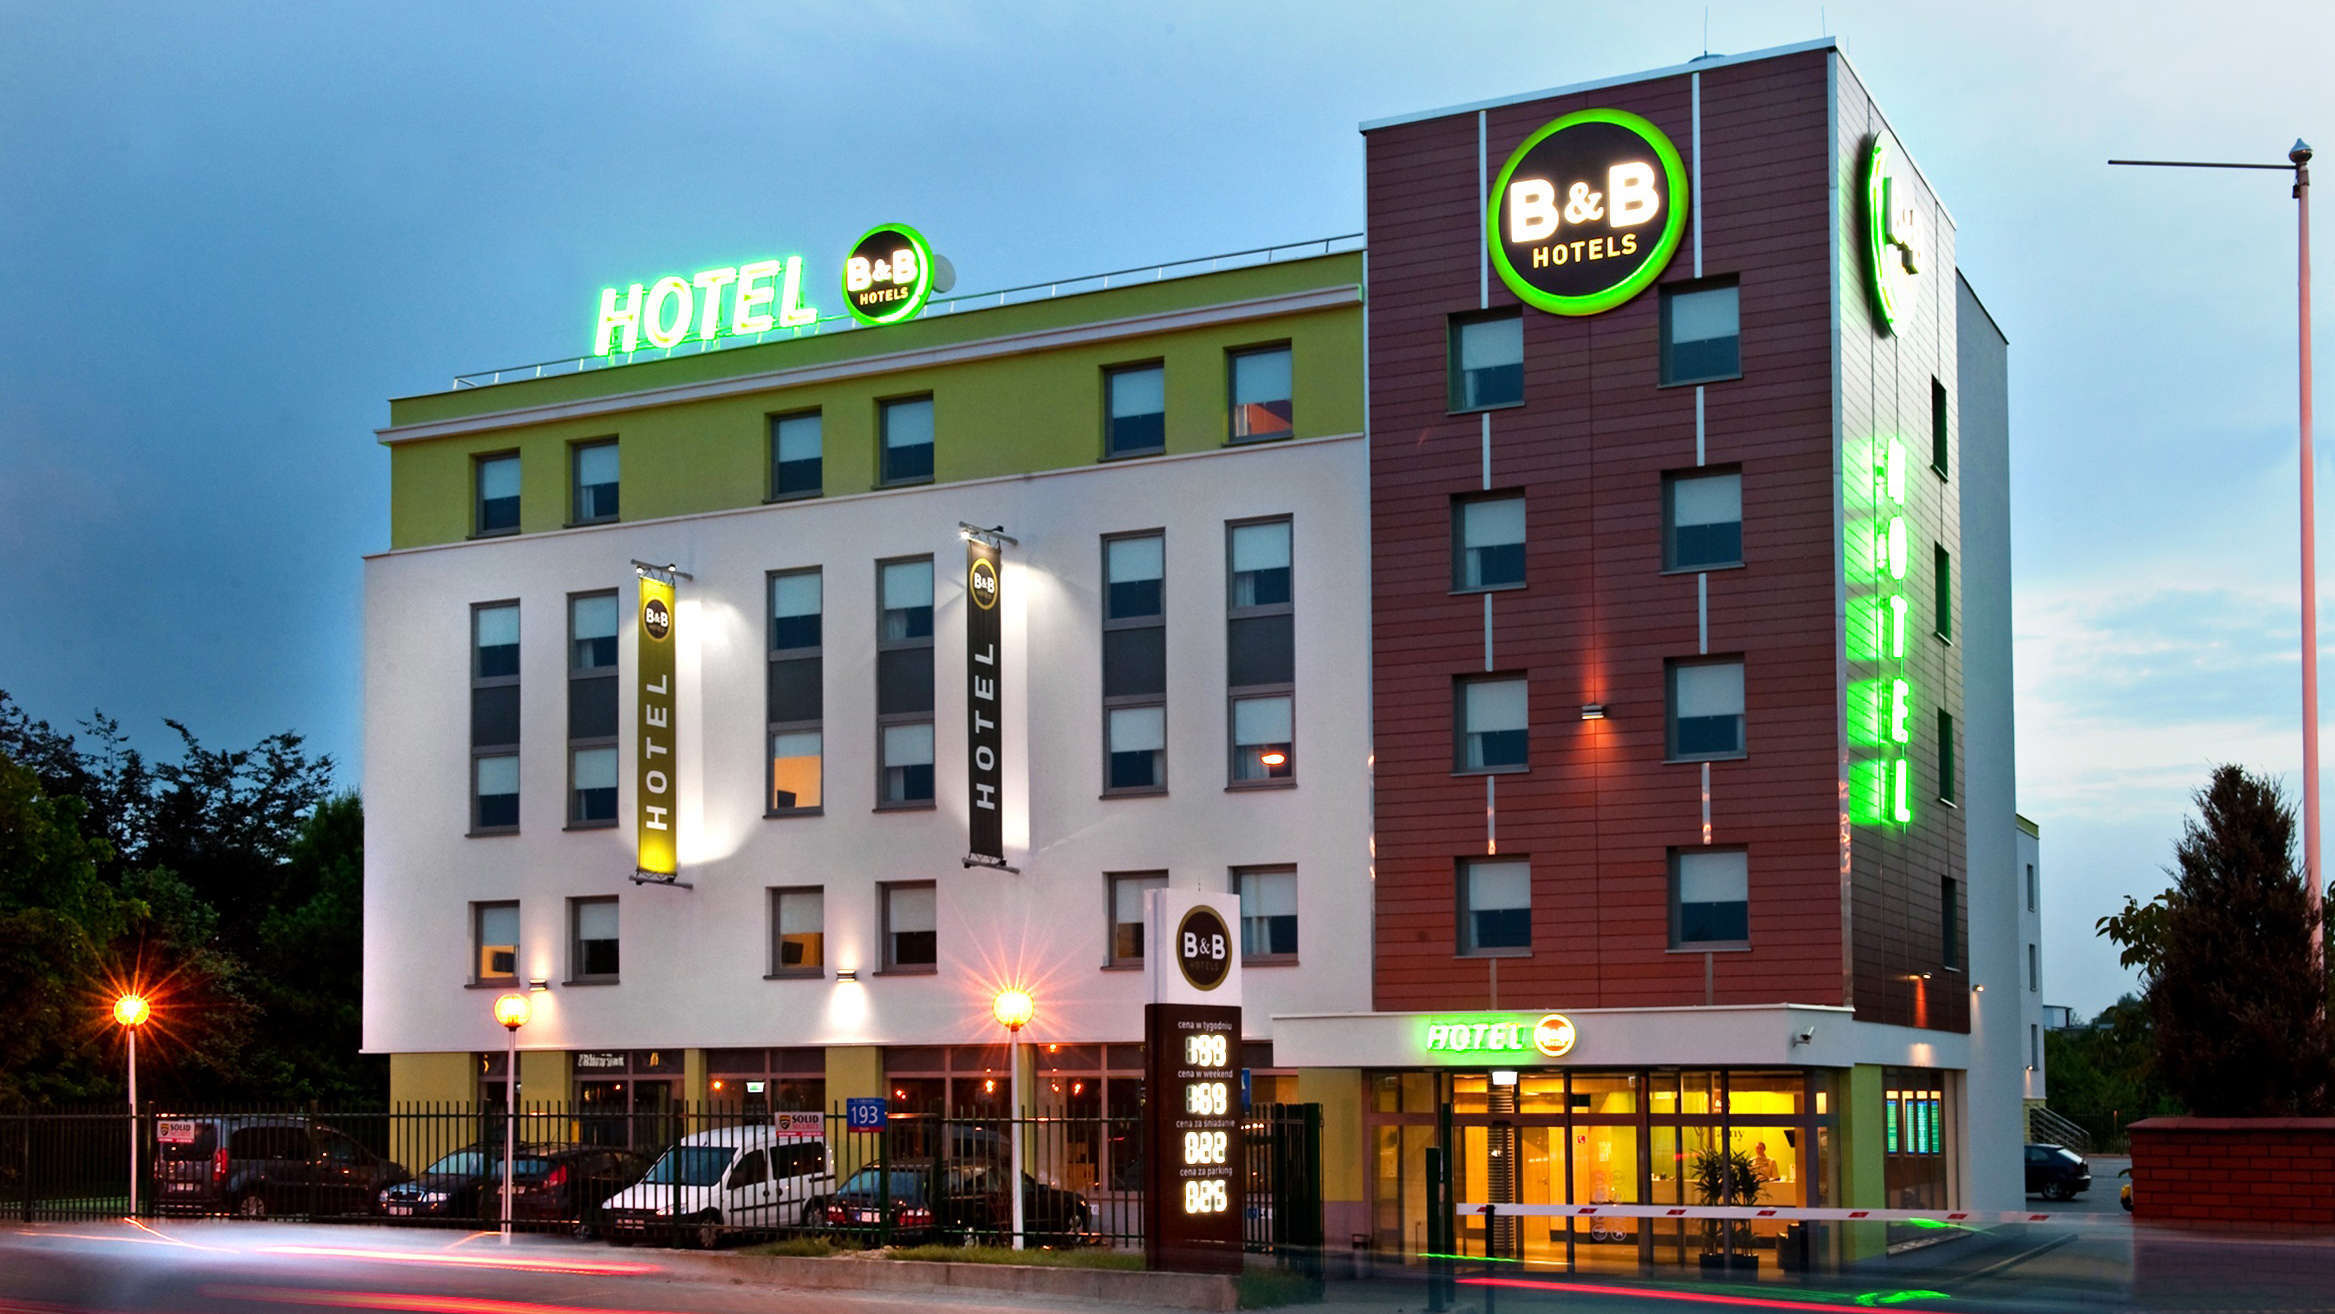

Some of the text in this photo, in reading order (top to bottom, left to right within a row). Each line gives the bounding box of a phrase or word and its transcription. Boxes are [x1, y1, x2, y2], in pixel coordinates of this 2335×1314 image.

[1511, 162, 1659, 242] B&B
[1533, 233, 1637, 268] HOTELS
[847, 249, 918, 291] B&B
[860, 287, 908, 305] HOTELS
[594, 256, 817, 356] HOTEL
[974, 573, 995, 593] B&B
[646, 608, 669, 627] B&B
[974, 644, 995, 811] HOTEL
[646, 674, 667, 831] HOTEL
[1184, 932, 1225, 960] B&B
[1177, 1021, 1194, 1029] cena
[1427, 1023, 1523, 1050] HOTEL
[1177, 1070, 1194, 1078] cena
[1203, 1070, 1233, 1078] weekend
[792, 1114, 819, 1123] SOLID
[851, 1105, 878, 1124] 193
[1176, 1120, 1193, 1128] cena
[170, 1123, 191, 1131] SOLID
[1180, 1168, 1197, 1177] cena
[1207, 1166, 1233, 1177] parking
